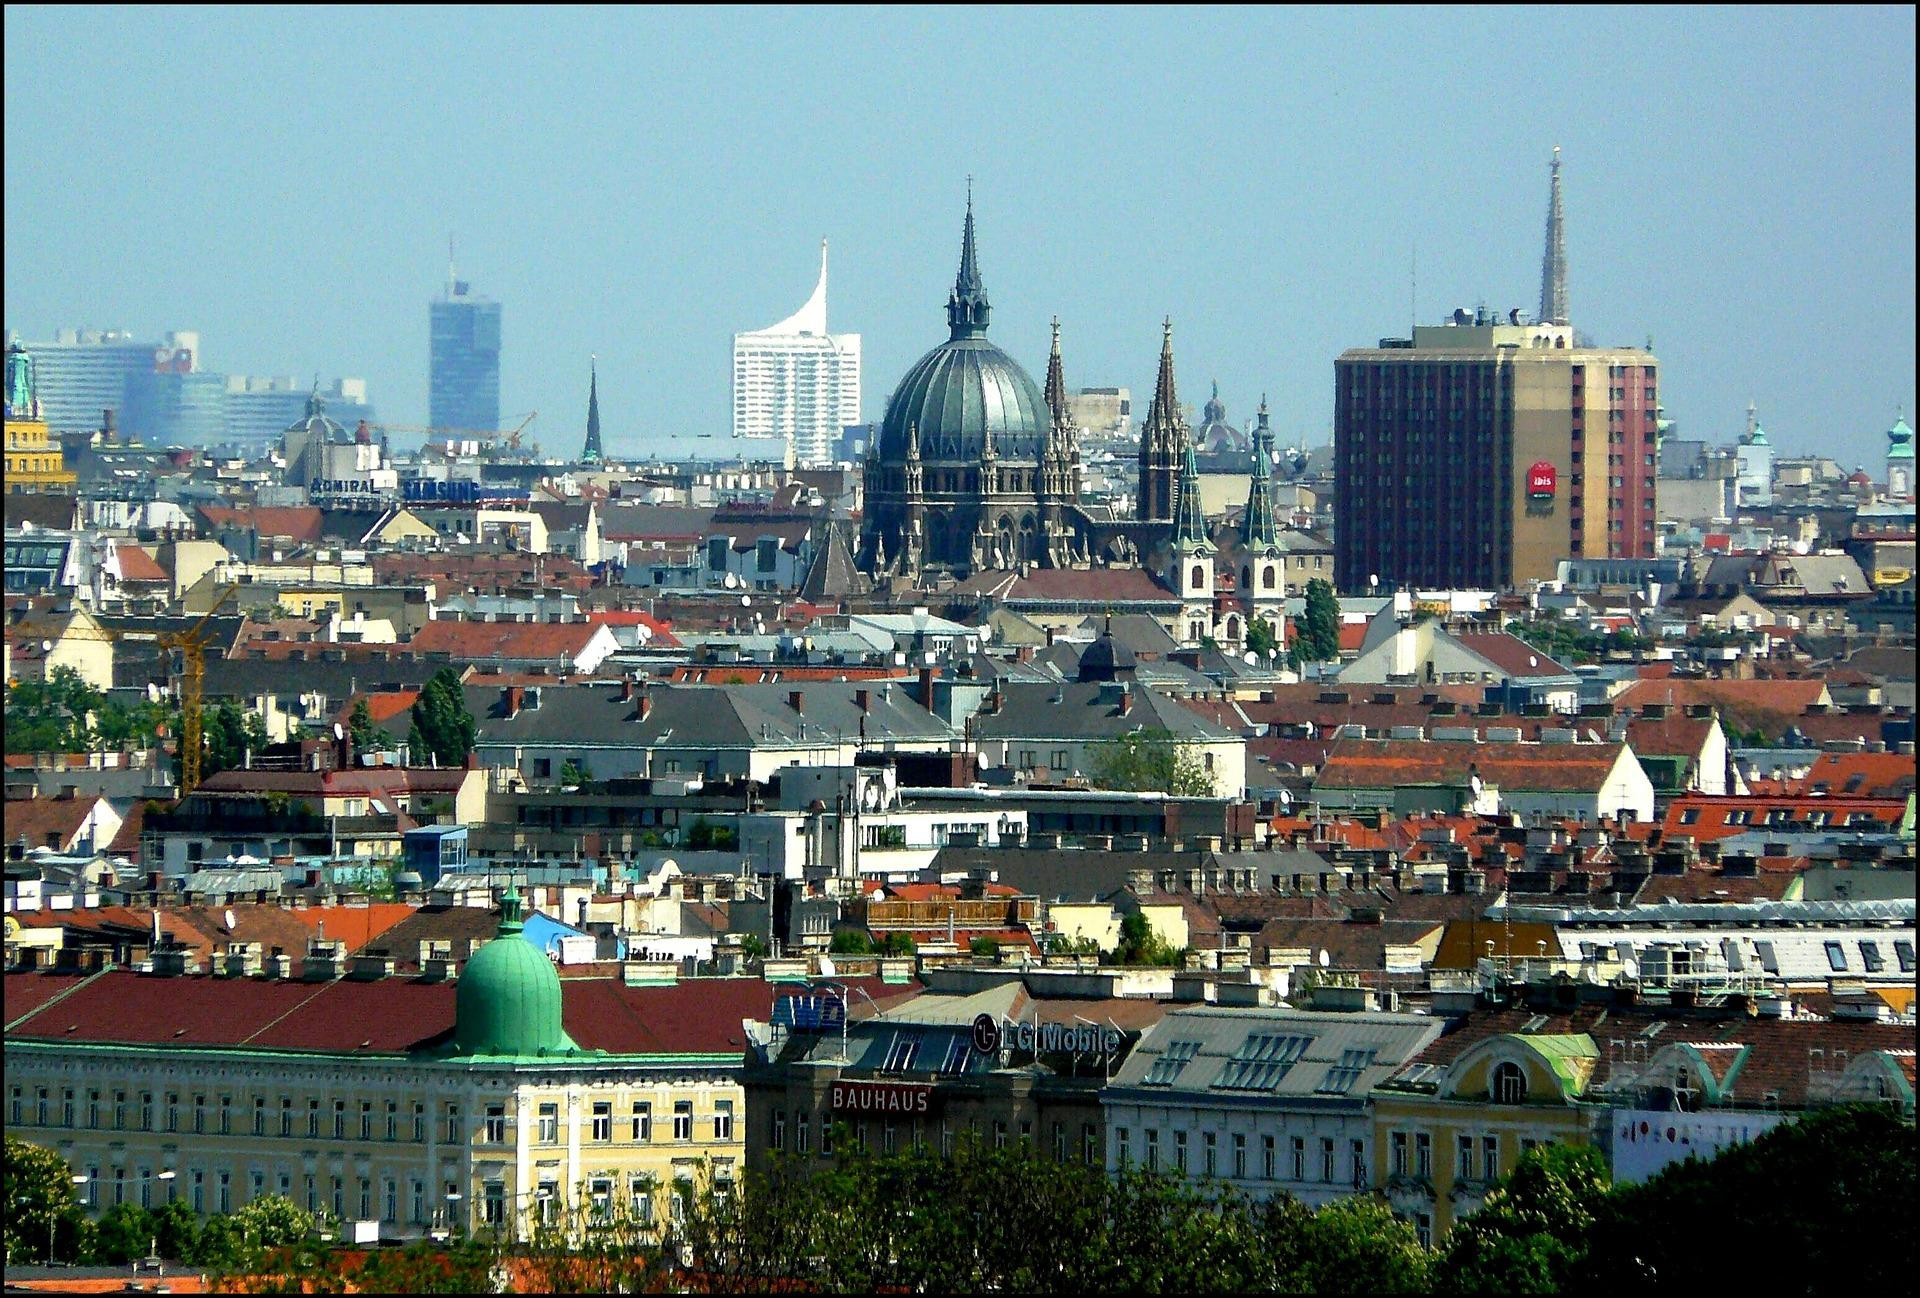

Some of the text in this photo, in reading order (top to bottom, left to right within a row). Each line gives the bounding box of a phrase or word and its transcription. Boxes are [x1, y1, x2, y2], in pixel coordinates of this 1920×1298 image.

[310, 478, 380, 494] ADMIRAL
[1533, 475, 1552, 486] ibis
[1002, 1021, 1034, 1051] LG
[1041, 1021, 1120, 1052] Mobile
[833, 1087, 927, 1112] BAUHAUS
